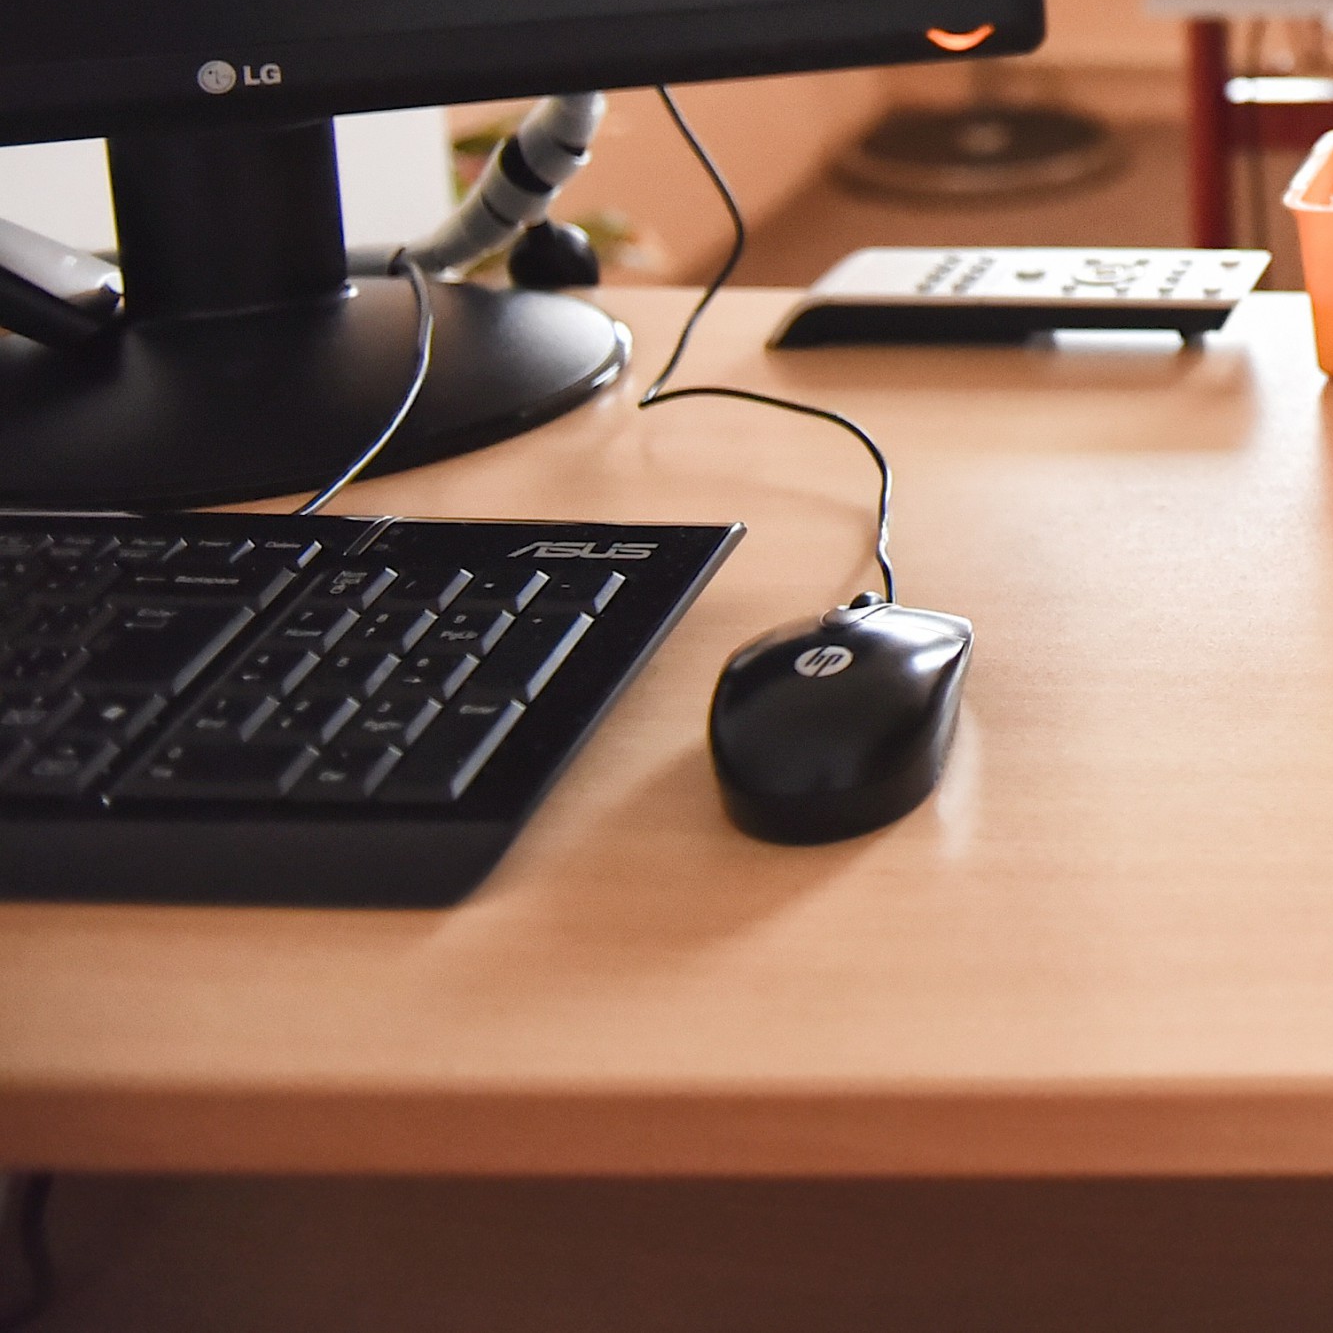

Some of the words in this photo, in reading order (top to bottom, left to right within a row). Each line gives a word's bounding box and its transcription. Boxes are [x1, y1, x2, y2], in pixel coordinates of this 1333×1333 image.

[242, 63, 282, 86] LG
[506, 541, 660, 560] ASUS
[798, 645, 850, 678] hp
